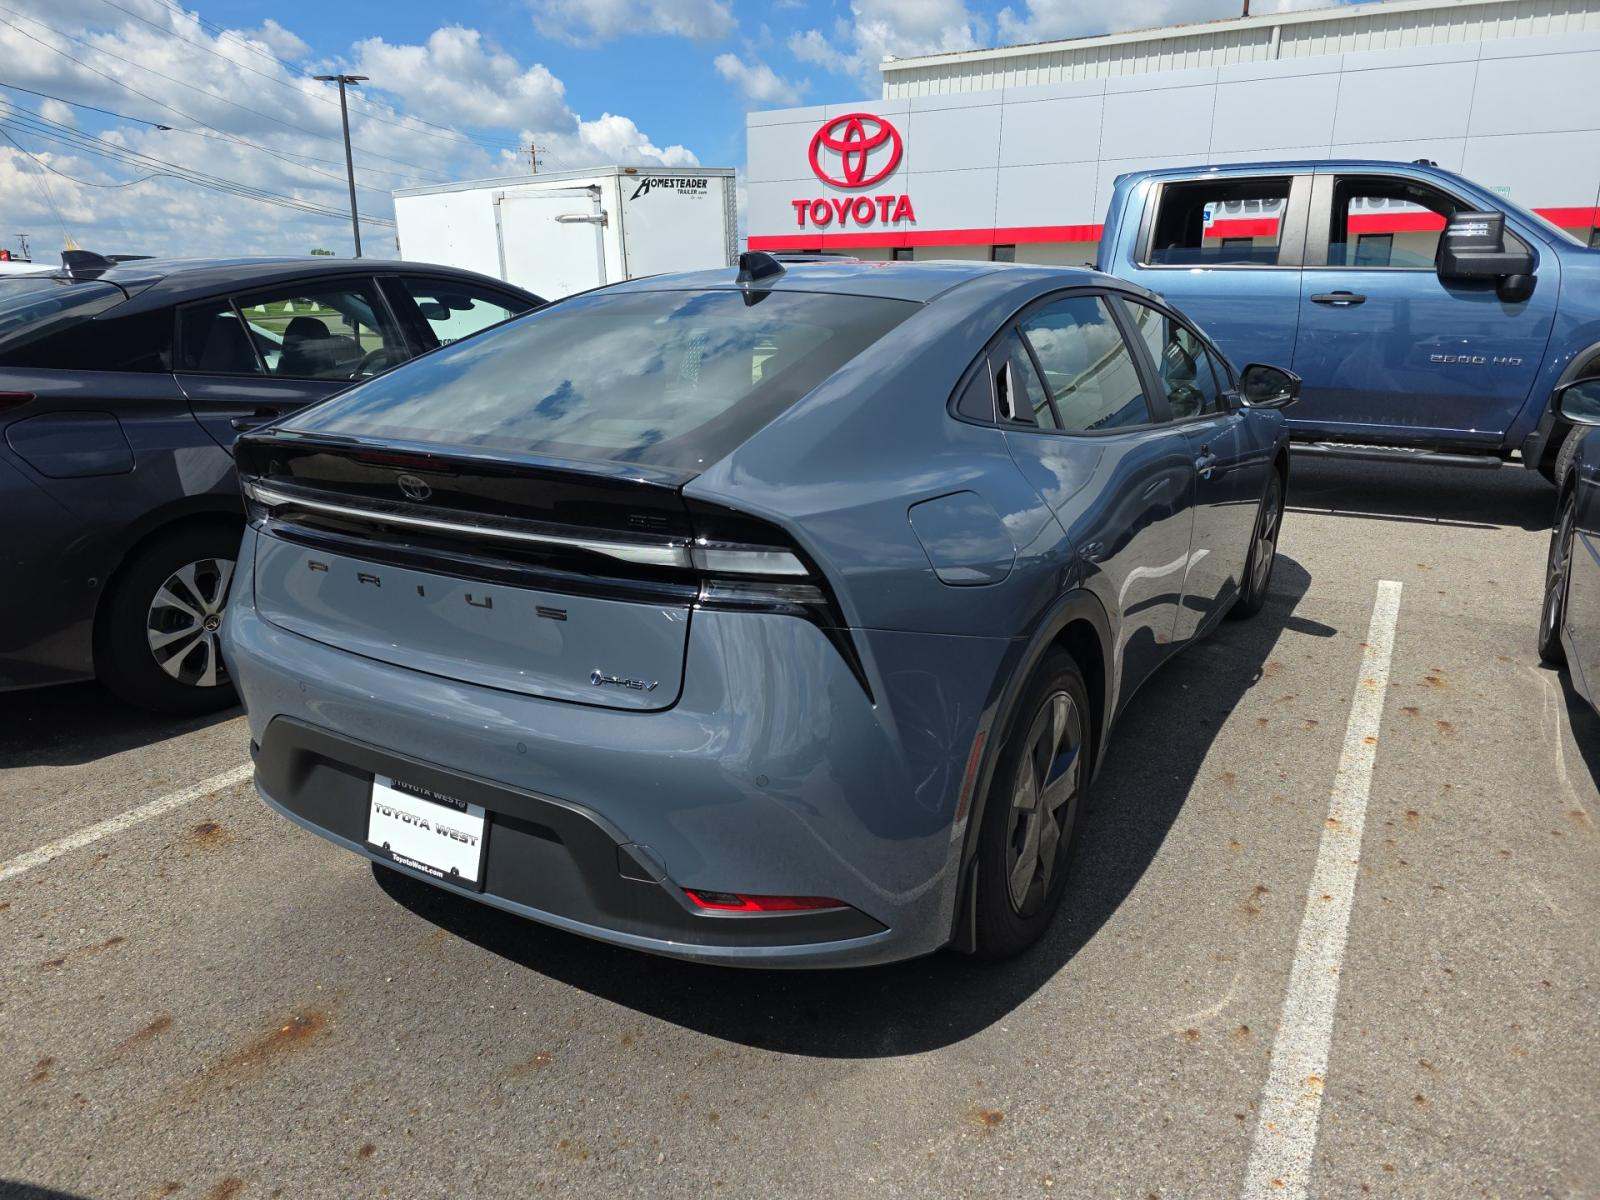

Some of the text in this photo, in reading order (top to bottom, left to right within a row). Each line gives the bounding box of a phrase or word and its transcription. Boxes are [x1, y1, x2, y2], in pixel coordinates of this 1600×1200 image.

[630, 177, 708, 201] HOMESTEADER
[792, 195, 916, 227] TOYOTA
[308, 560, 568, 621] PRIUS
[433, 791, 462, 805] WEST
[374, 802, 479, 846] TOYOTA WEST
[392, 853, 444, 878] ToyotaWest.com
